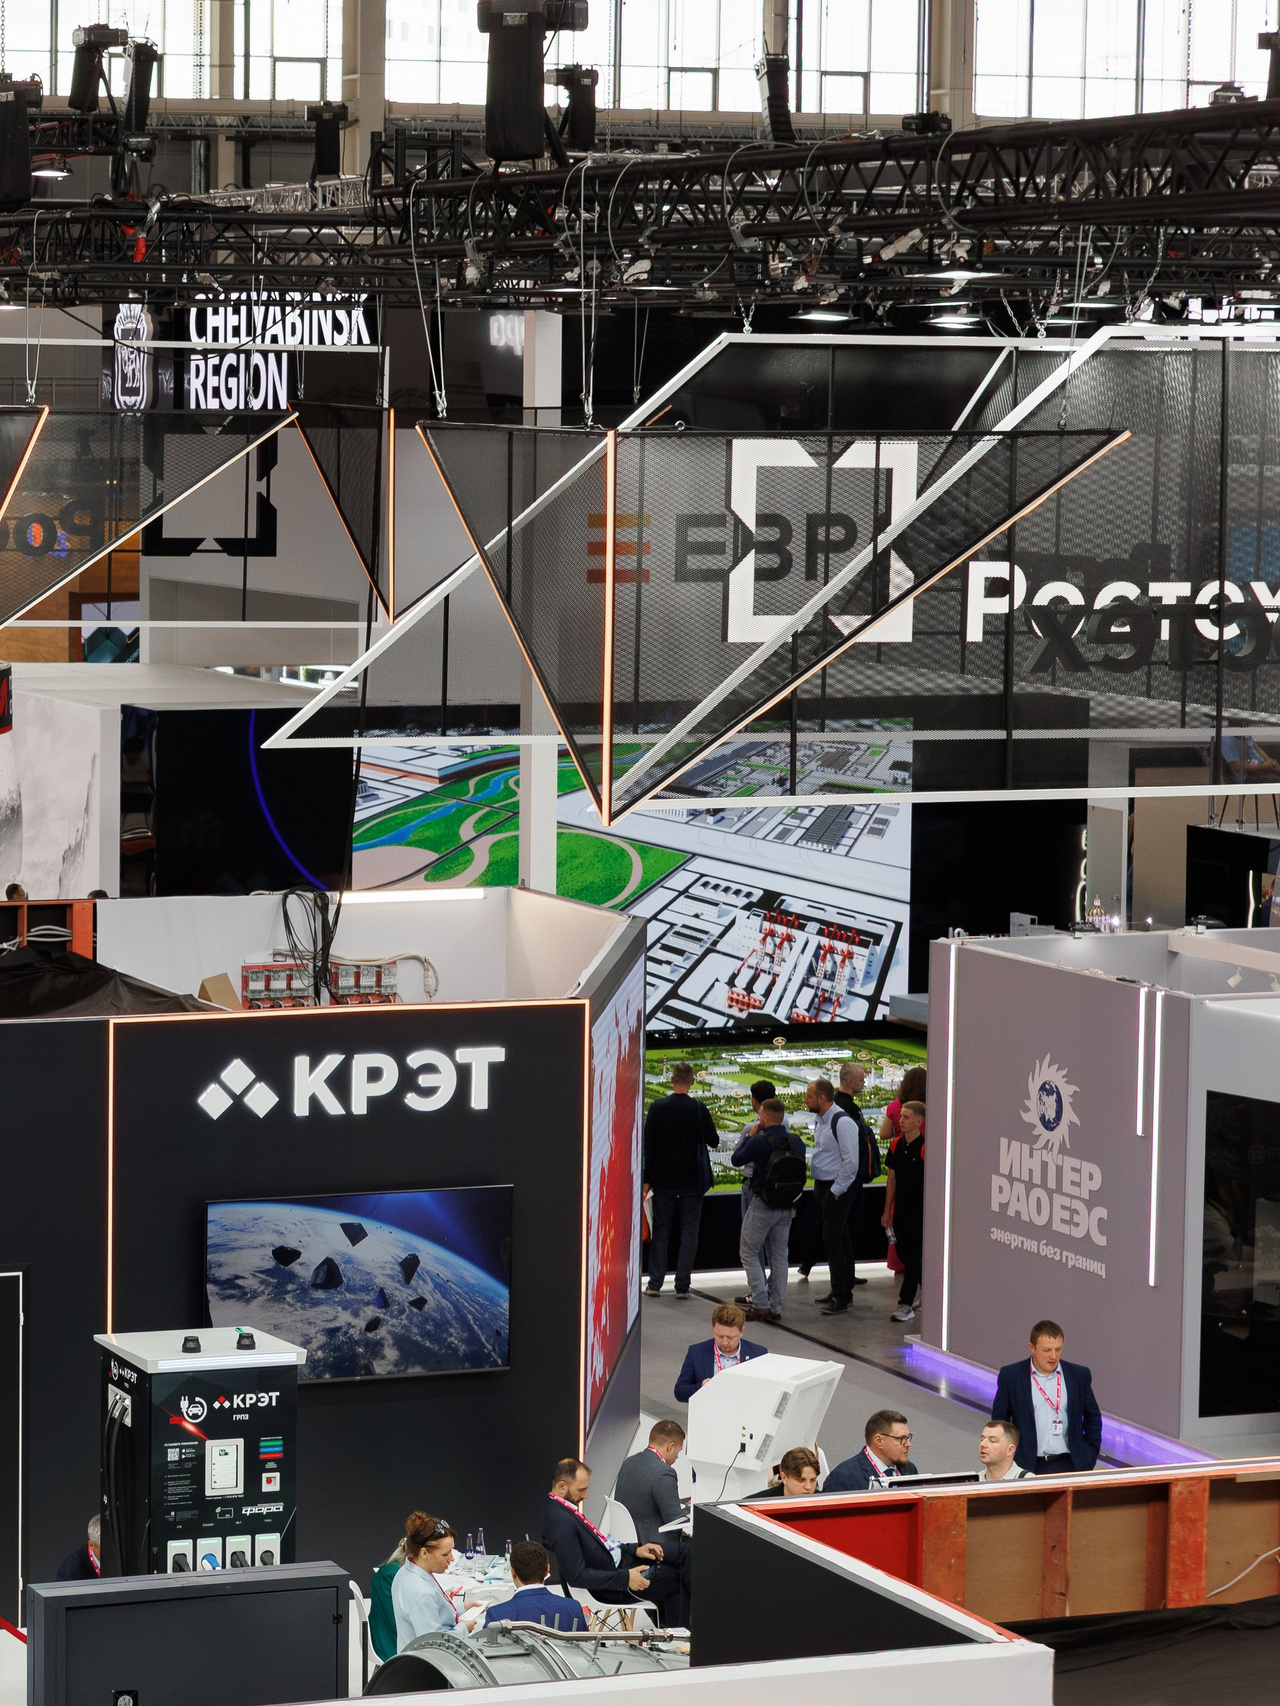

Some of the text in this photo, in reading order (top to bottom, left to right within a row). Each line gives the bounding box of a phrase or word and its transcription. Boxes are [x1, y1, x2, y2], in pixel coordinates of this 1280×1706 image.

[190, 292, 371, 346] CHELYABINSK
[190, 352, 288, 410] REGION
[294, 1047, 506, 1117] КРЭТ
[999, 1136, 1102, 1200] ИНТЕР
[991, 1173, 1108, 1246] РАО ЕЭС
[990, 1227, 1106, 1279] энергия без границ
[124, 1367, 138, 1384] КРЭТ
[233, 1391, 280, 1409] КРЭТ
[233, 1413, 249, 1421] ГРПЗ
